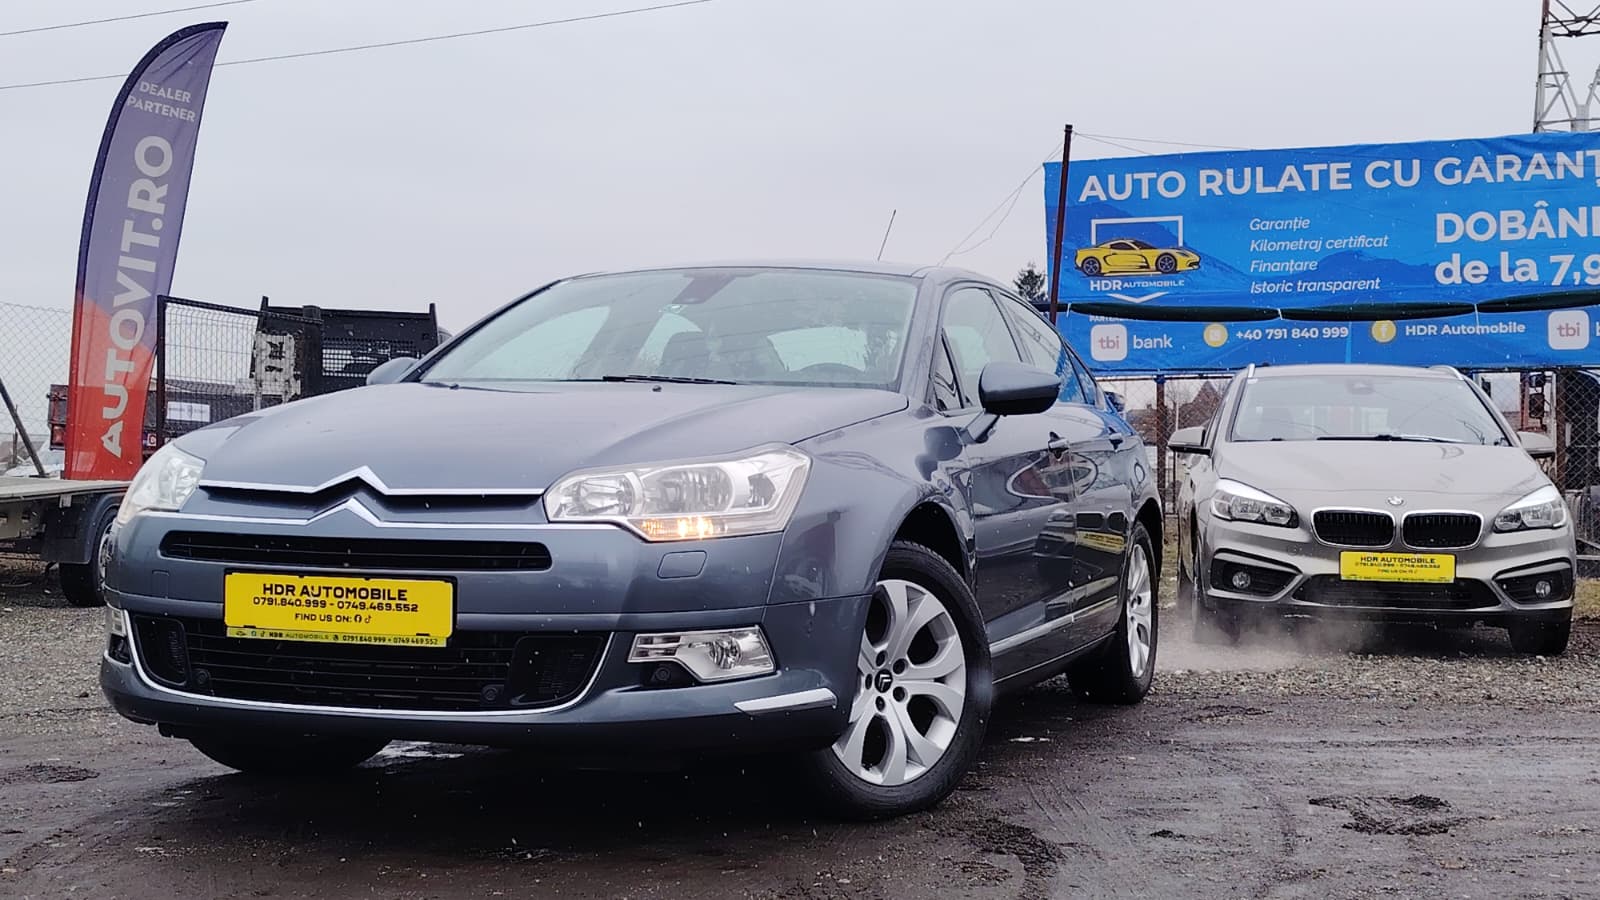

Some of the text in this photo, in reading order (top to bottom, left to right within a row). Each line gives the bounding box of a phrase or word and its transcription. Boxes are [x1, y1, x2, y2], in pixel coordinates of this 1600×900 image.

[139, 81, 192, 104] DEALER
[127, 95, 196, 122] PARTENER
[1078, 170, 1187, 202] AUTO
[1199, 162, 1352, 197] RULATE
[1364, 159, 1421, 189] CU
[1250, 217, 1311, 232] Garanție
[1250, 235, 1389, 252] Kilometraj certificat
[1250, 259, 1318, 274] Finanțare
[1435, 253, 1489, 285] de
[1500, 251, 1539, 283] la
[1089, 279, 1185, 291] HDR AUTOMOBILE
[1250, 277, 1381, 294] Istoric transparent
[101, 135, 173, 458] AUTOVIT.RO
[1236, 326, 1349, 340] +40 791 840 999
[1405, 322, 1525, 336] HDR Automobile
[1556, 321, 1581, 337] tbi
[1098, 334, 1173, 349] tbi bank
[263, 583, 408, 601] HDR AUTOMOBILE
[253, 596, 327, 608] 0791.840.999
[337, 600, 418, 613] 0749.469.552
[295, 613, 317, 621] FIND
[319, 614, 333, 622] US
